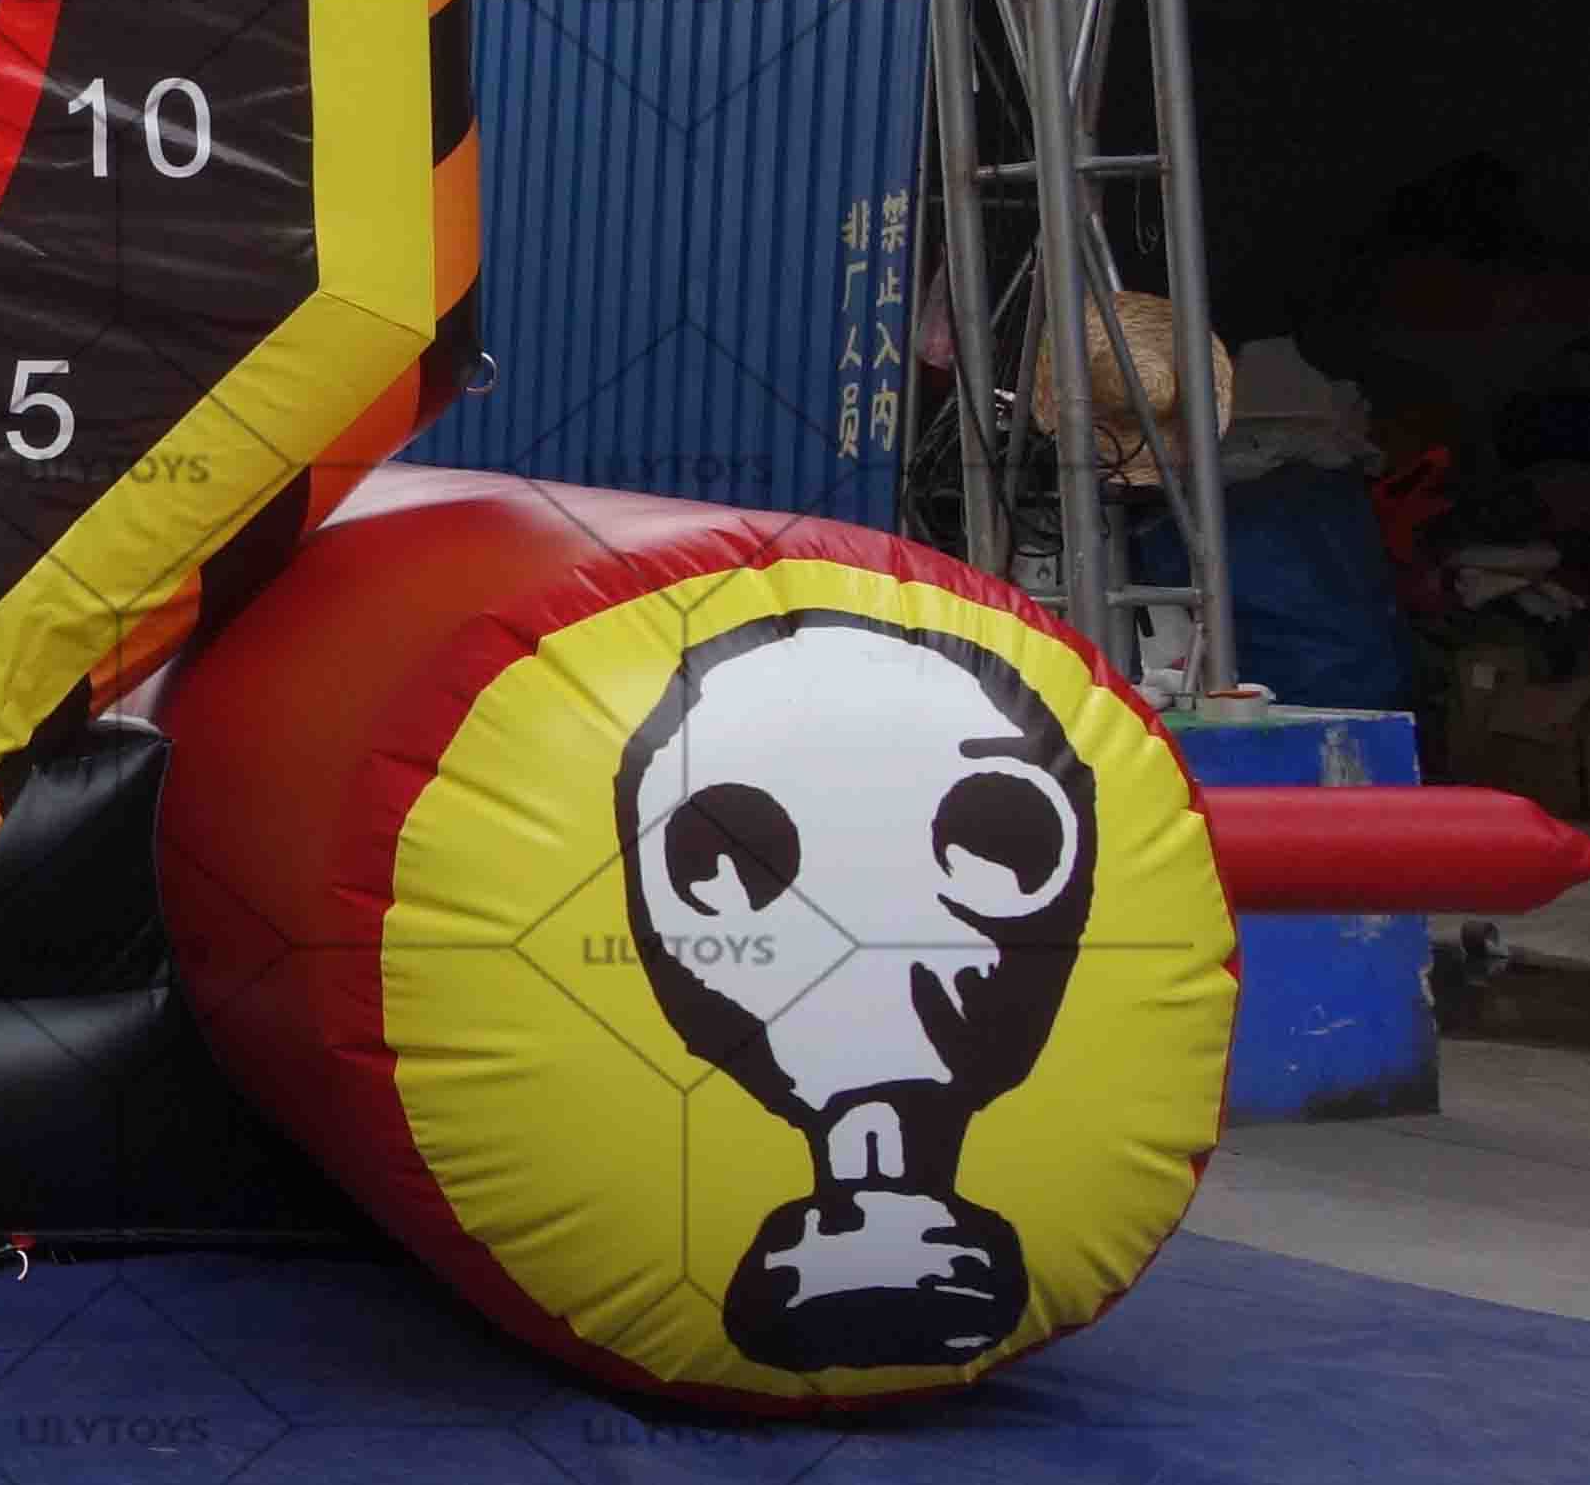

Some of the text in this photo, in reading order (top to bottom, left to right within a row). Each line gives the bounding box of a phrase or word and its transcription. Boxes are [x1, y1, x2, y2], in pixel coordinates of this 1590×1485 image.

[66, 76, 213, 179] 10
[837, 198, 872, 460] 非厂人员
[870, 188, 910, 453] 禁止入内
